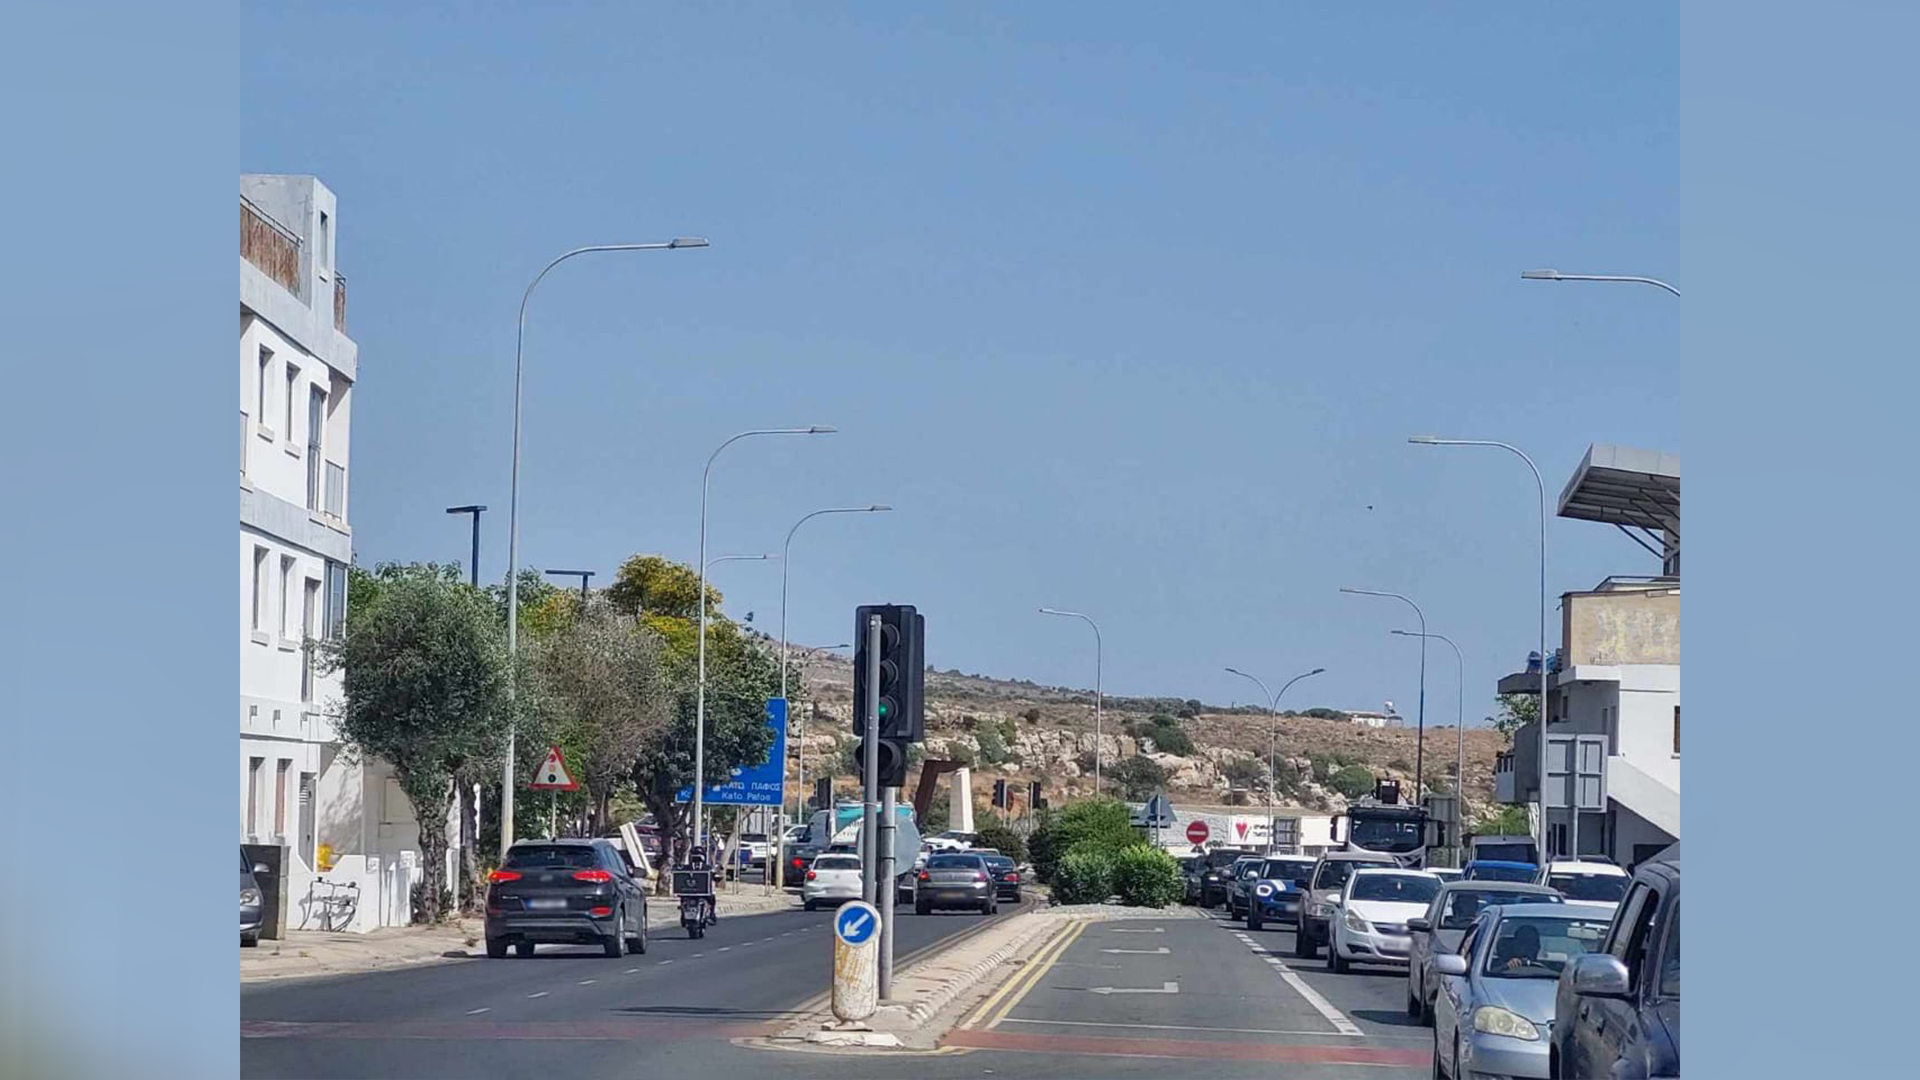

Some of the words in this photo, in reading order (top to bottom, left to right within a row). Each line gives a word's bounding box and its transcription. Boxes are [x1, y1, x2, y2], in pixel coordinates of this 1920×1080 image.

[751, 782, 780, 791] ΠΑΦΟΣ
[722, 792, 743, 800] Kato
[747, 793, 771, 801] Pafos
